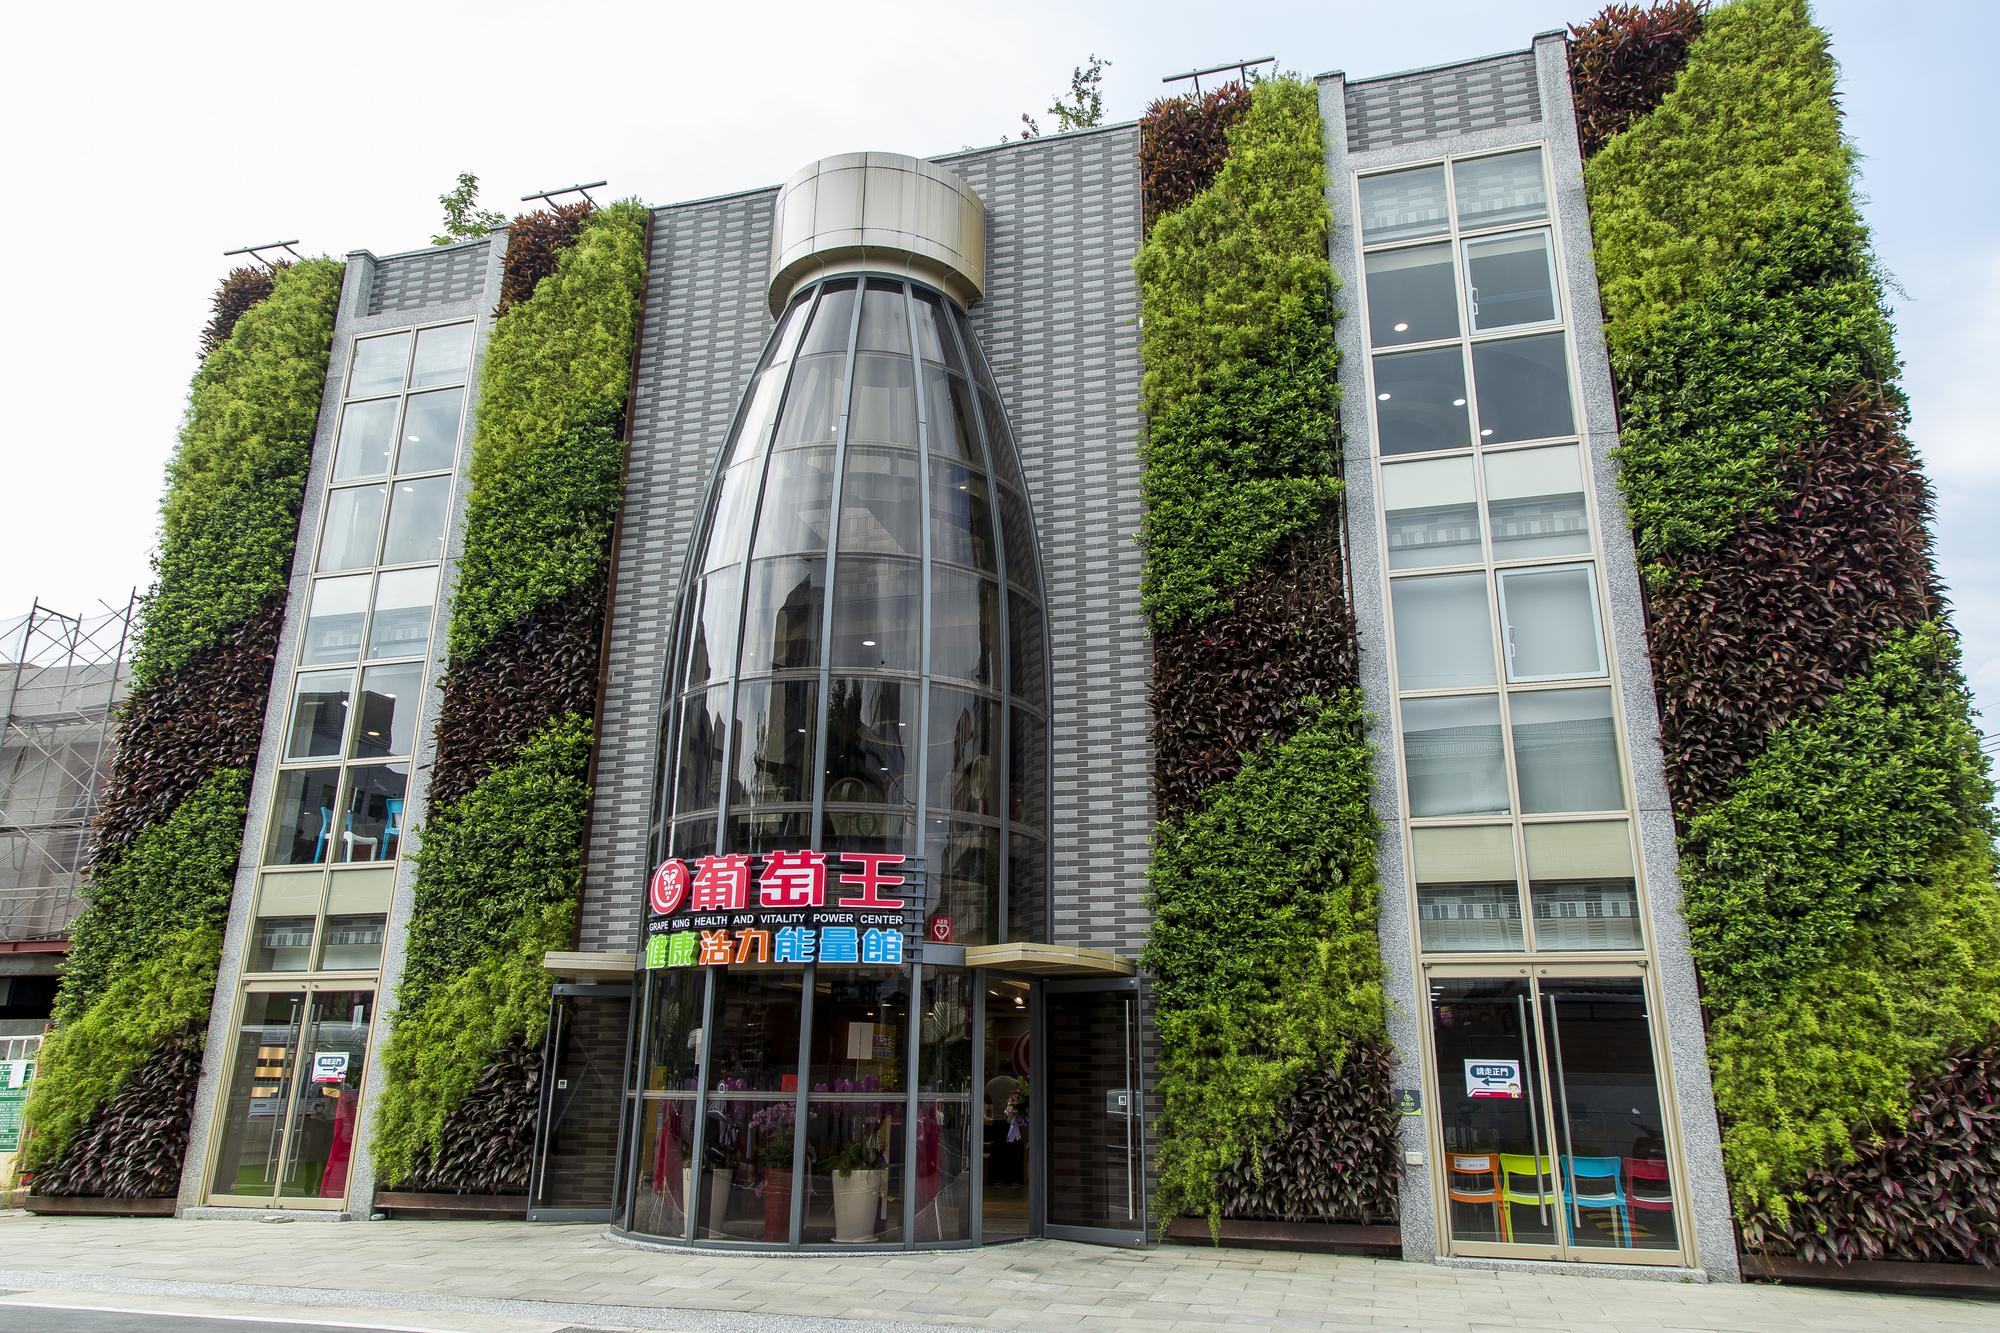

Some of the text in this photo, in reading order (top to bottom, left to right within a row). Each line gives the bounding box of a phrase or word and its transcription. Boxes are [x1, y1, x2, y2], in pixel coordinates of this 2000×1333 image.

[692, 850, 905, 910] 葡萄王
[649, 913, 903, 931] GRAPE KING HEALTH AND VITALITY POWER CENTER
[936, 918, 949, 926] AED
[645, 926, 904, 969] 健康活力能量館
[1476, 1067, 1509, 1076] 請走正門
